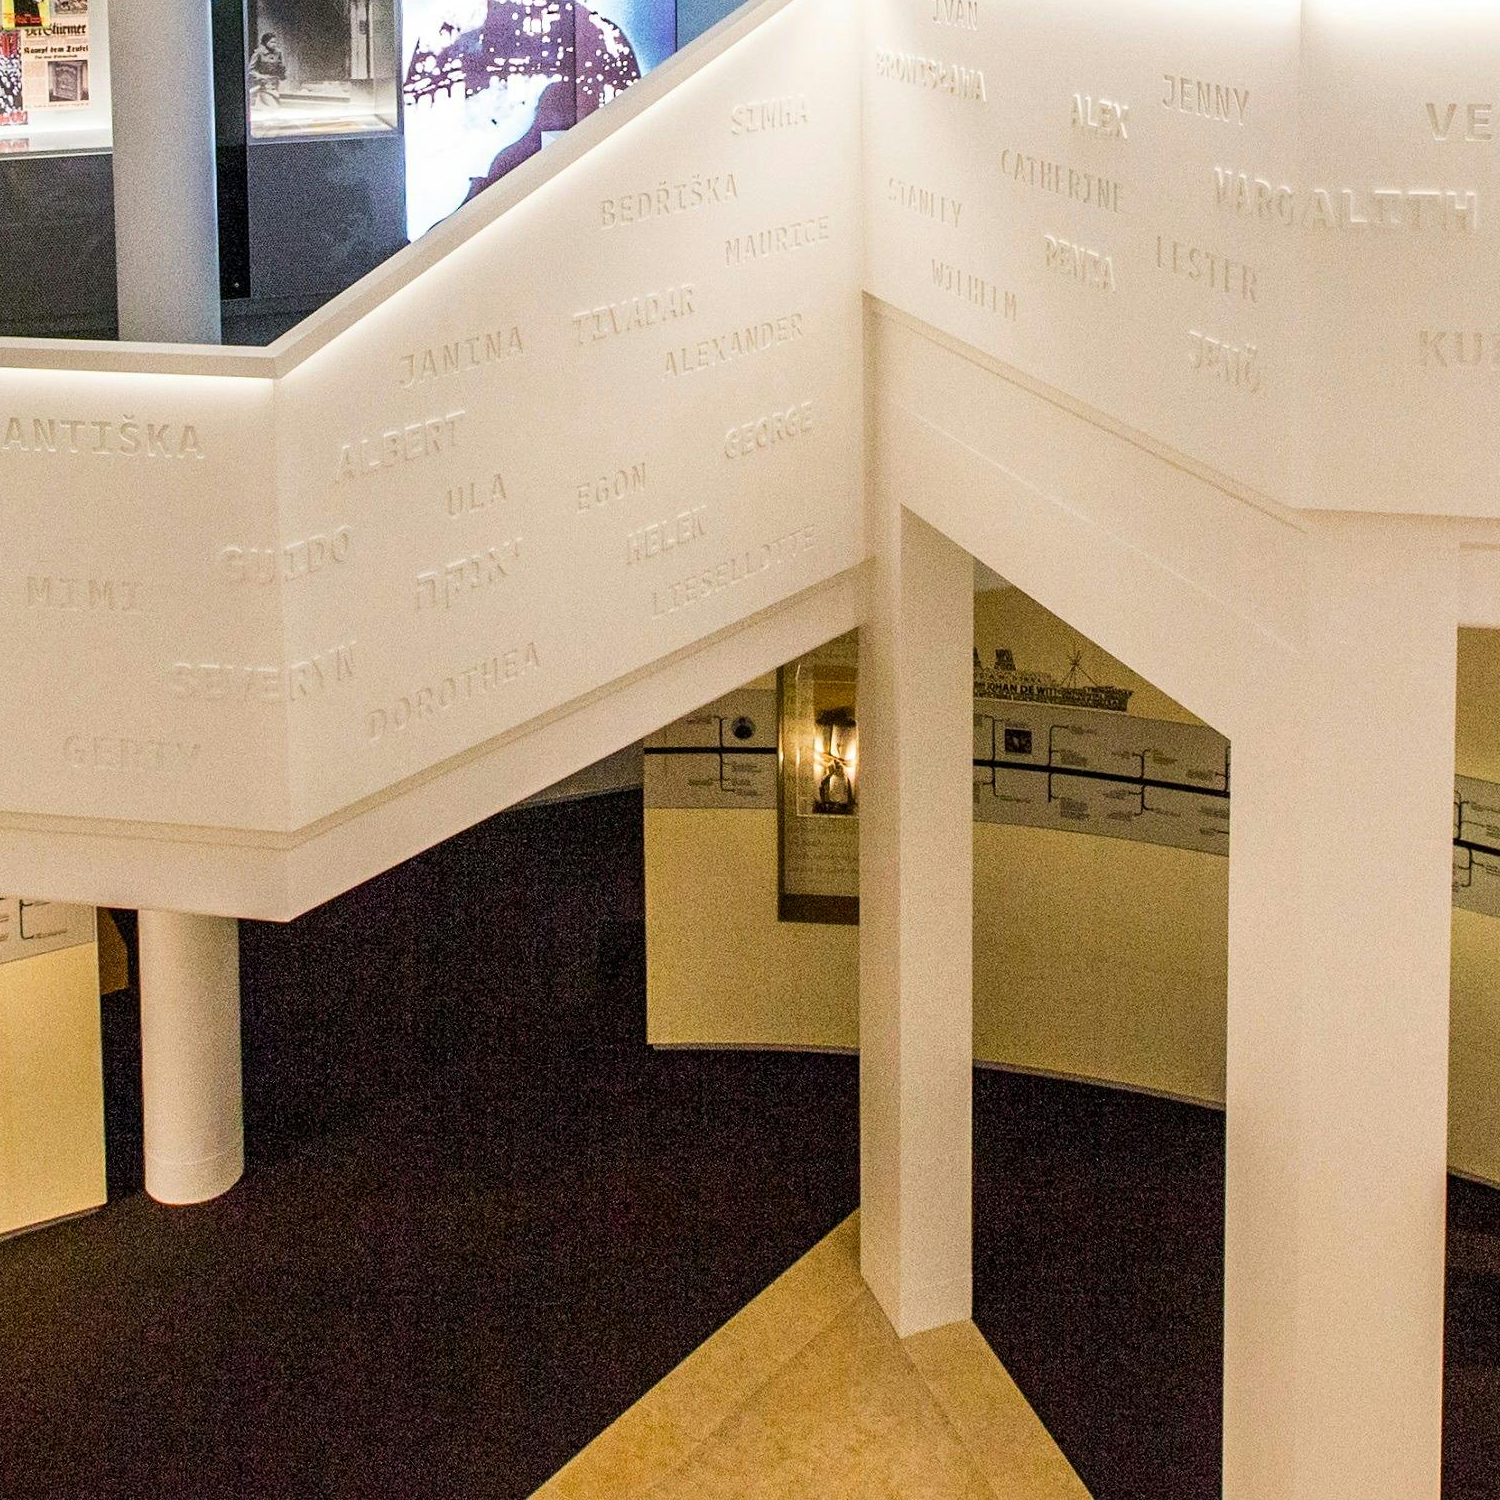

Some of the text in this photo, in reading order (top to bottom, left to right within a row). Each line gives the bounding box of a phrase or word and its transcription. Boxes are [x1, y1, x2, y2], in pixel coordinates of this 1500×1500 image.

[1070, 92, 1132, 141] ALEX
[1161, 73, 1251, 128] JENNY
[999, 147, 1126, 214] CATHERINE
[723, 214, 832, 267] MAURICE
[1154, 235, 1259, 305] LESTER
[399, 325, 527, 390] JANINA
[660, 310, 804, 382] ALEXANDER
[332, 408, 467, 486] ALBERT
[444, 471, 509, 521] ULA
[574, 460, 648, 514] EGON
[25, 573, 146, 616] MIMI
[369, 638, 541, 743] DOROTHEA
